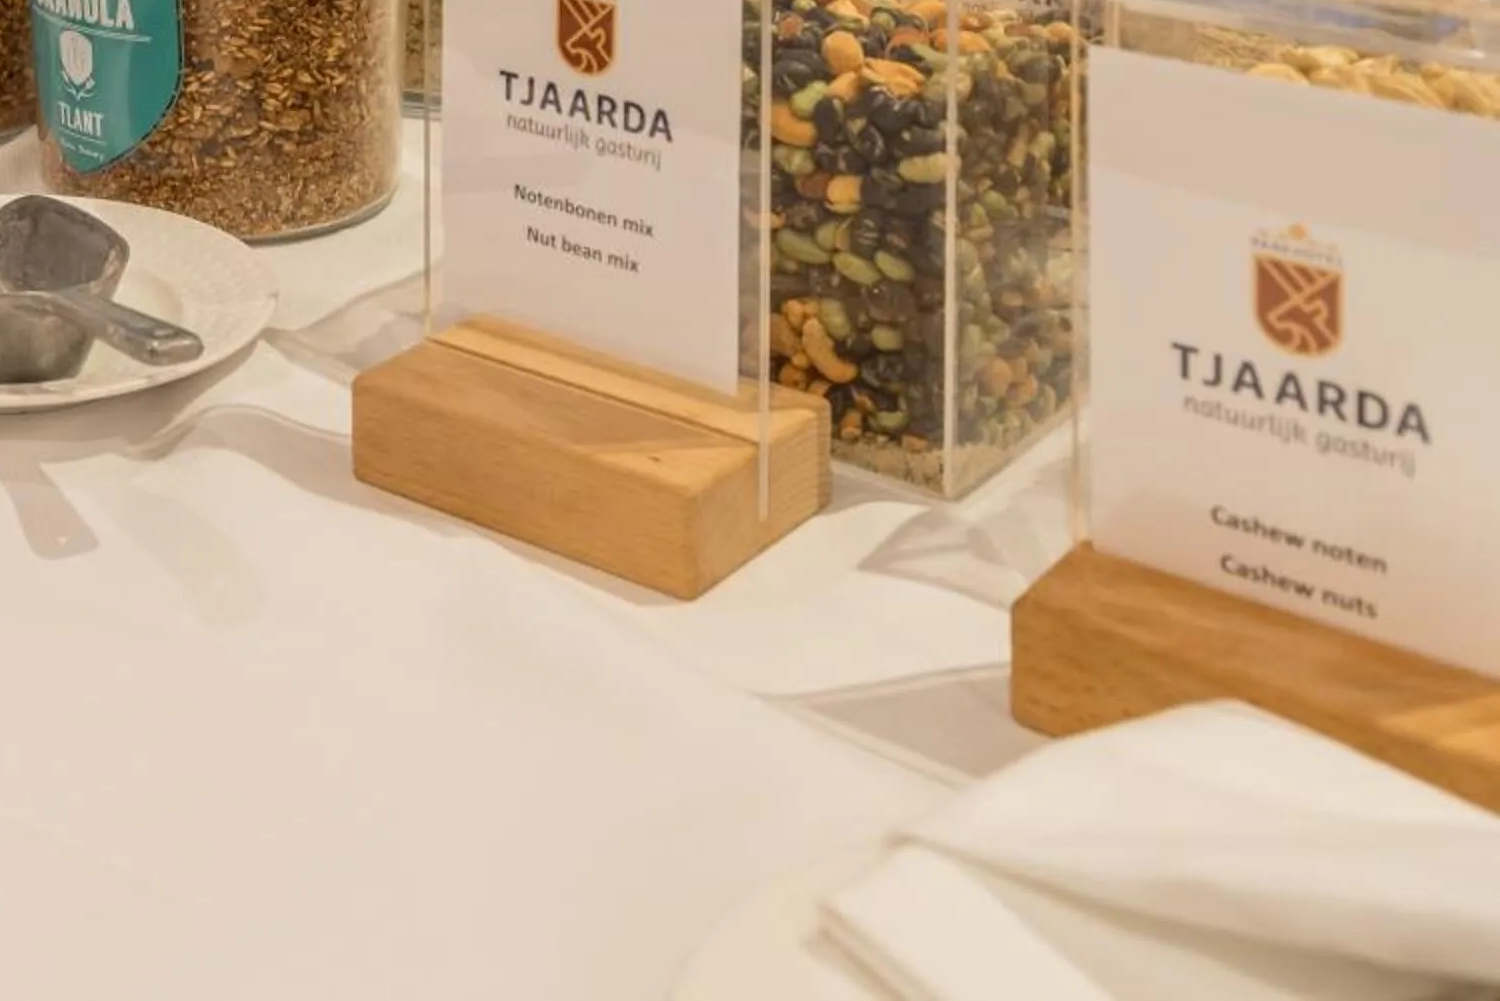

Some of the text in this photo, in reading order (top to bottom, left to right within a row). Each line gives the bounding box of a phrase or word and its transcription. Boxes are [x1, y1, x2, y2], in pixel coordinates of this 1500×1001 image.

[58, 100, 105, 138] TLANT
[500, 70, 673, 143] TJAARDA
[506, 113, 591, 151] natuurlijk
[514, 183, 654, 238] Notenbonen mix
[526, 225, 640, 274] Nut bean mix
[1171, 342, 1433, 446] TJAARDA
[1182, 395, 1308, 446] natuurlijk
[1210, 504, 1388, 576] Cashew noten
[1219, 553, 1379, 620] Cashew nuts
